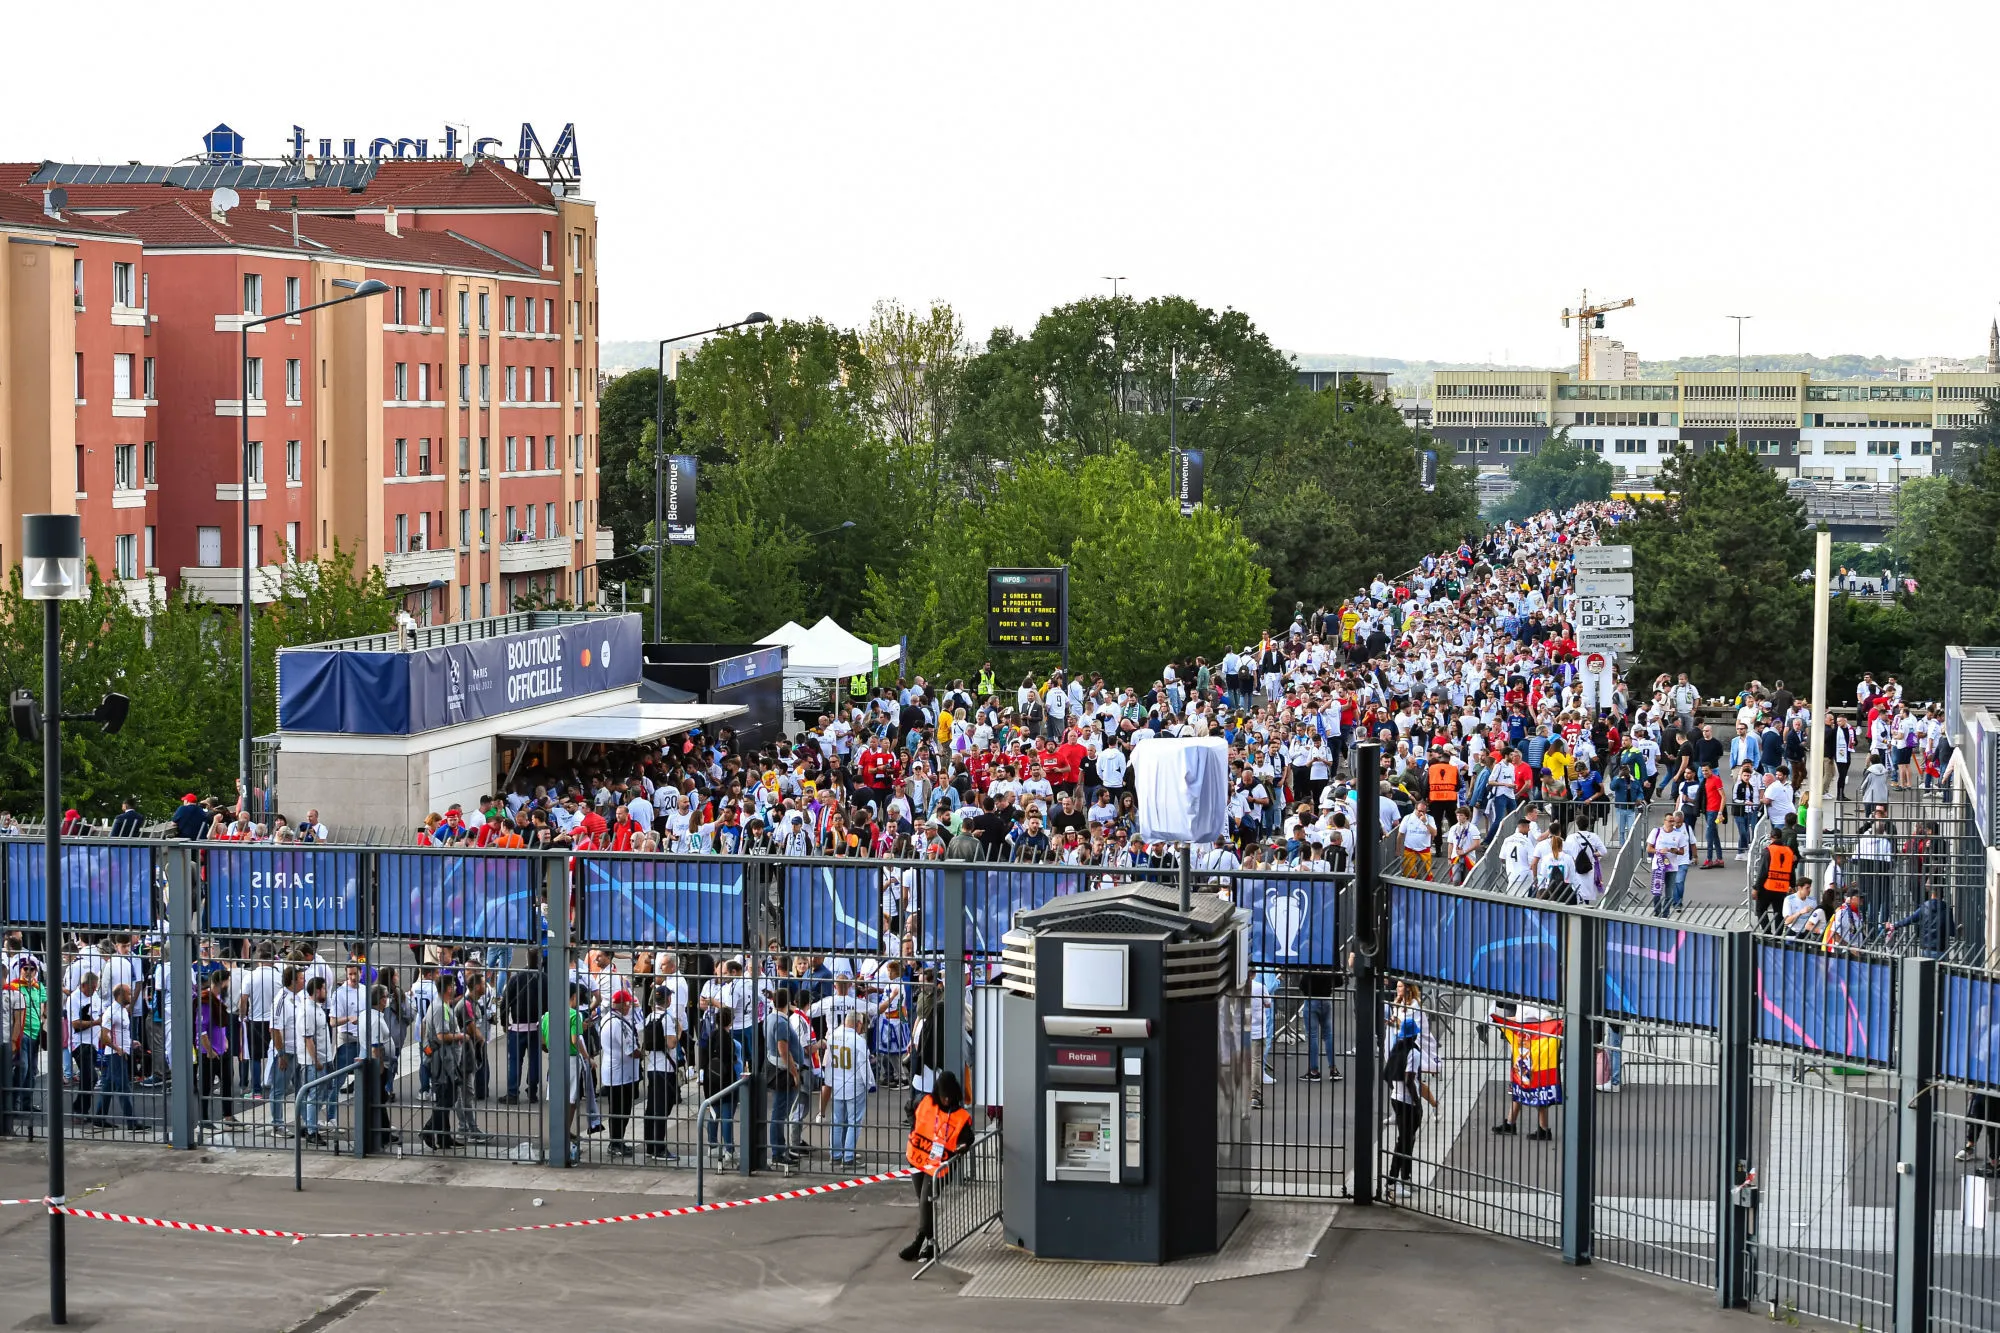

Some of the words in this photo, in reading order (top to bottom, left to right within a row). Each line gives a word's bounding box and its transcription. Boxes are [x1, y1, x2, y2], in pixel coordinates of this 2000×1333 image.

[508, 635, 562, 671] BOUTIQUE
[472, 668, 488, 680] PARIS
[508, 667, 563, 703] OFFICIELLE
[1056, 695, 1062, 707] 9
[664, 795, 678, 810] 20
[1510, 846, 1518, 862] 4
[1068, 1052, 1097, 1062] Retrait
